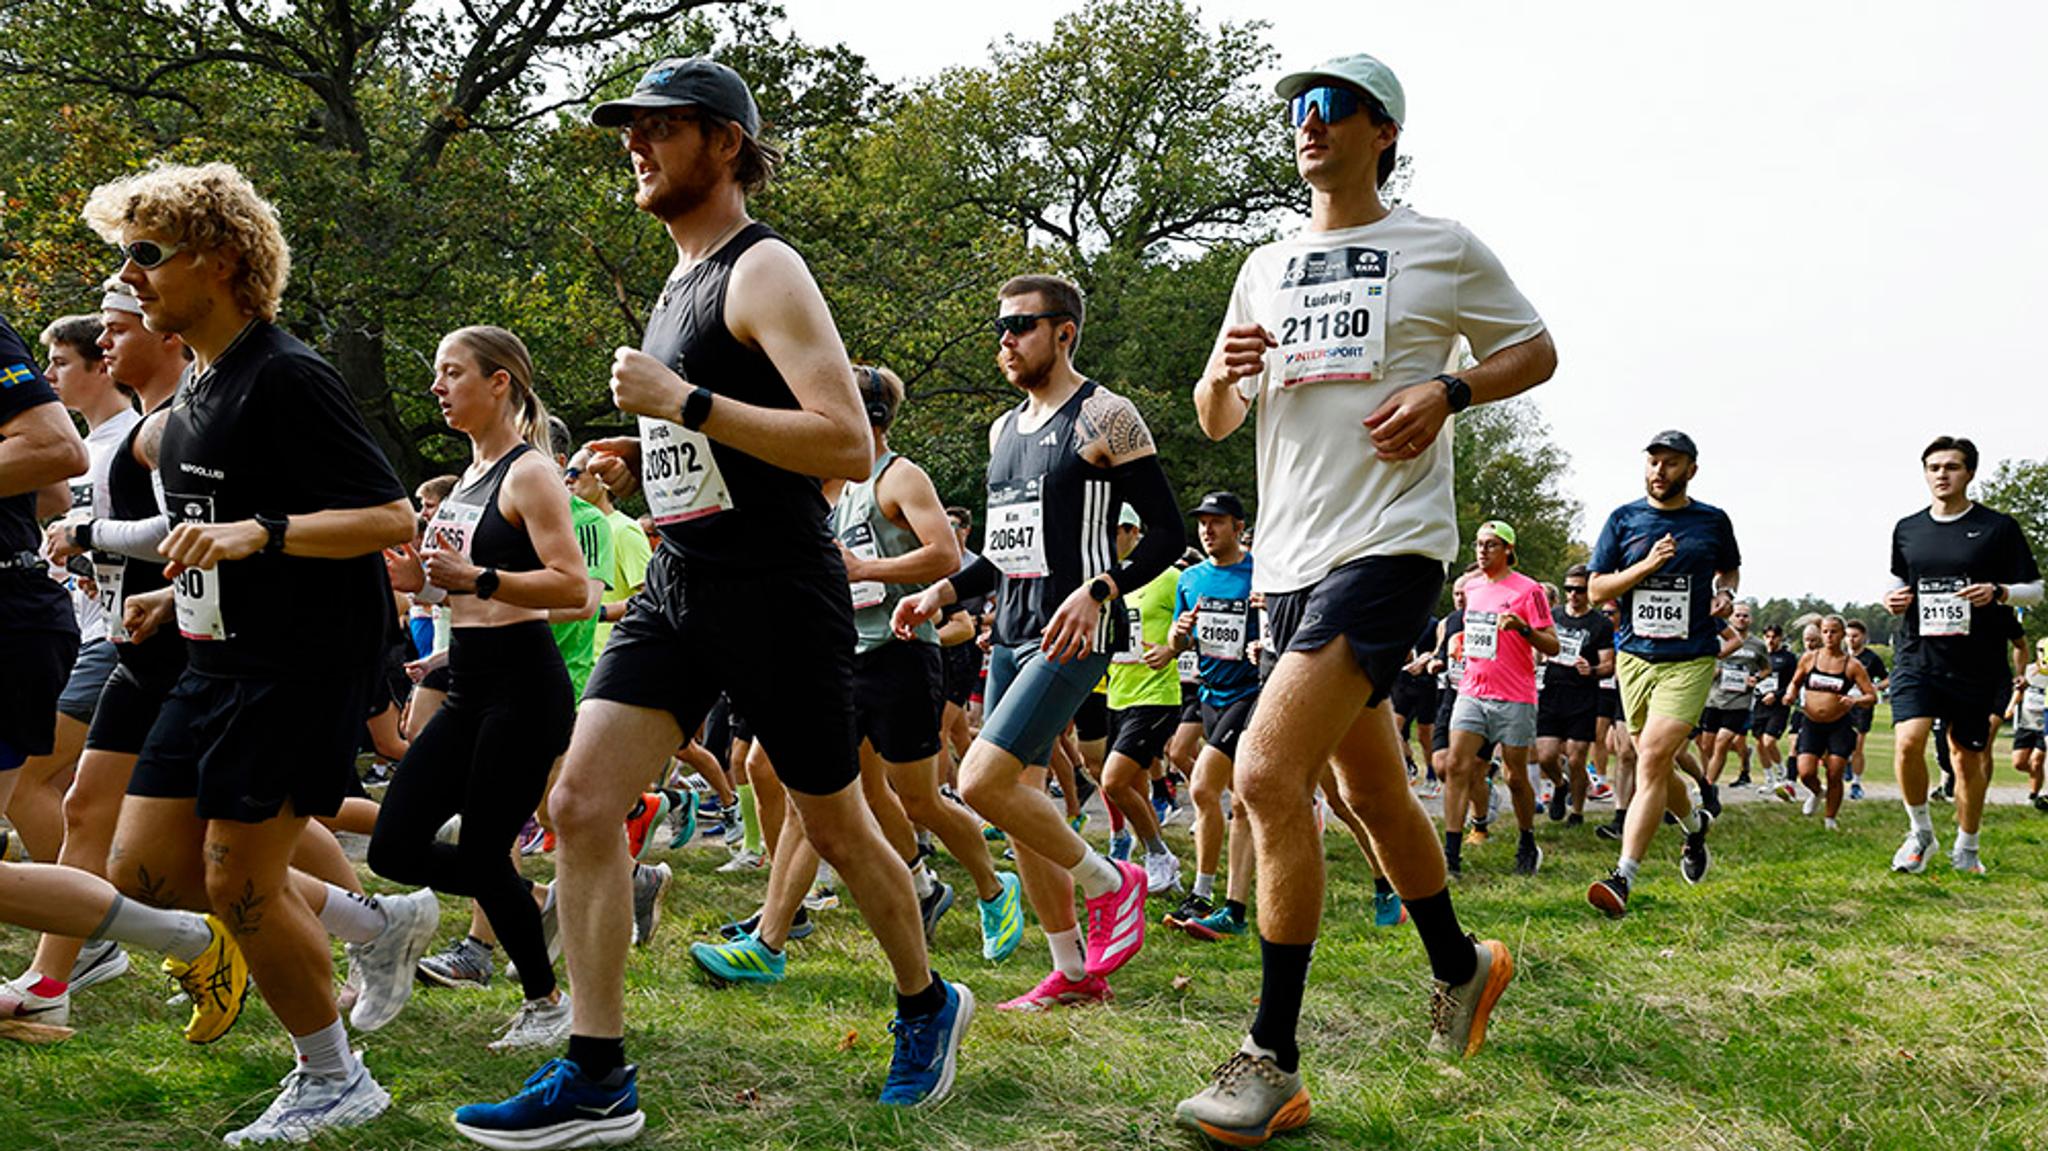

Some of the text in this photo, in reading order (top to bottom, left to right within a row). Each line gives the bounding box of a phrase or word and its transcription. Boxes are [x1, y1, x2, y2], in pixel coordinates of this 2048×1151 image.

[1355, 264, 1380, 272] TATA
[1304, 290, 1351, 308] Ludwig
[1282, 308, 1369, 346] 21180
[1295, 346, 1364, 361] INTERSPORT
[989, 526, 1034, 550] 20647
[1638, 604, 1682, 621] 20164
